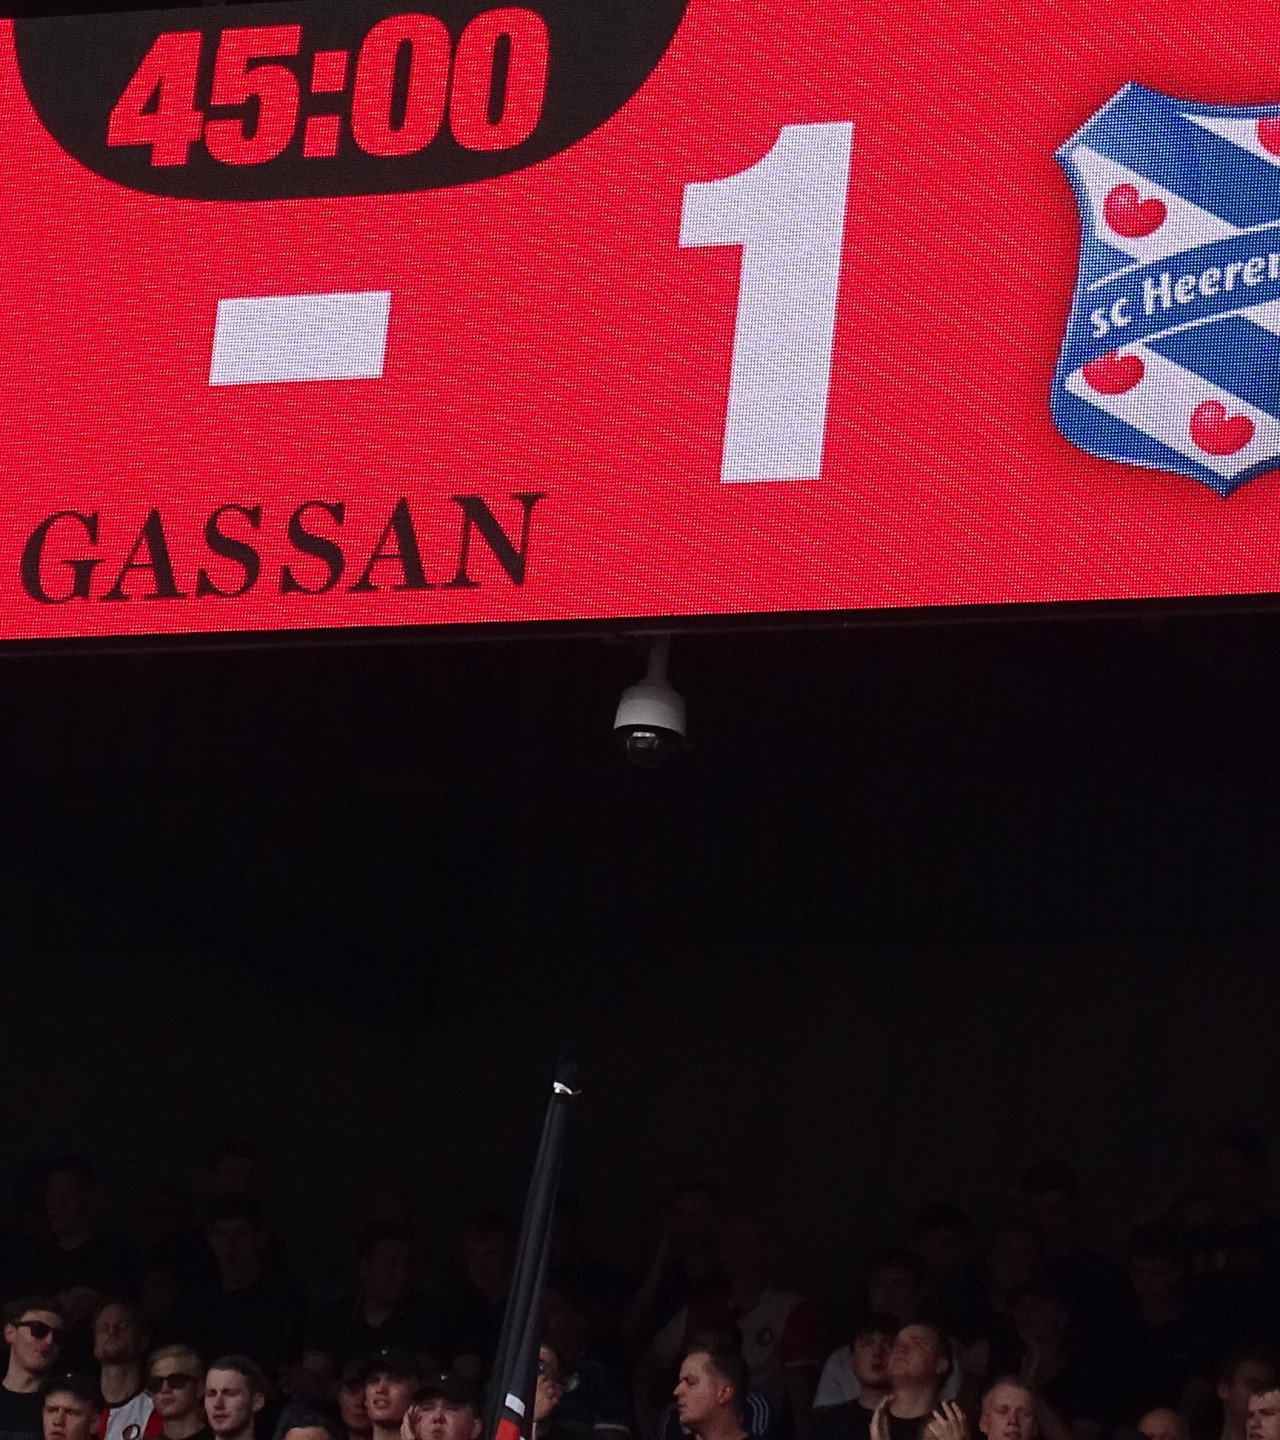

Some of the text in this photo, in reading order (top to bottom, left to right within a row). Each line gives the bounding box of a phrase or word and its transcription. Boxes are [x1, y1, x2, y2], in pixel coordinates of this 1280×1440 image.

[107, 7, 550, 167] 45:00
[678, 120, 855, 485] 1
[19, 490, 547, 605] GASSAN
